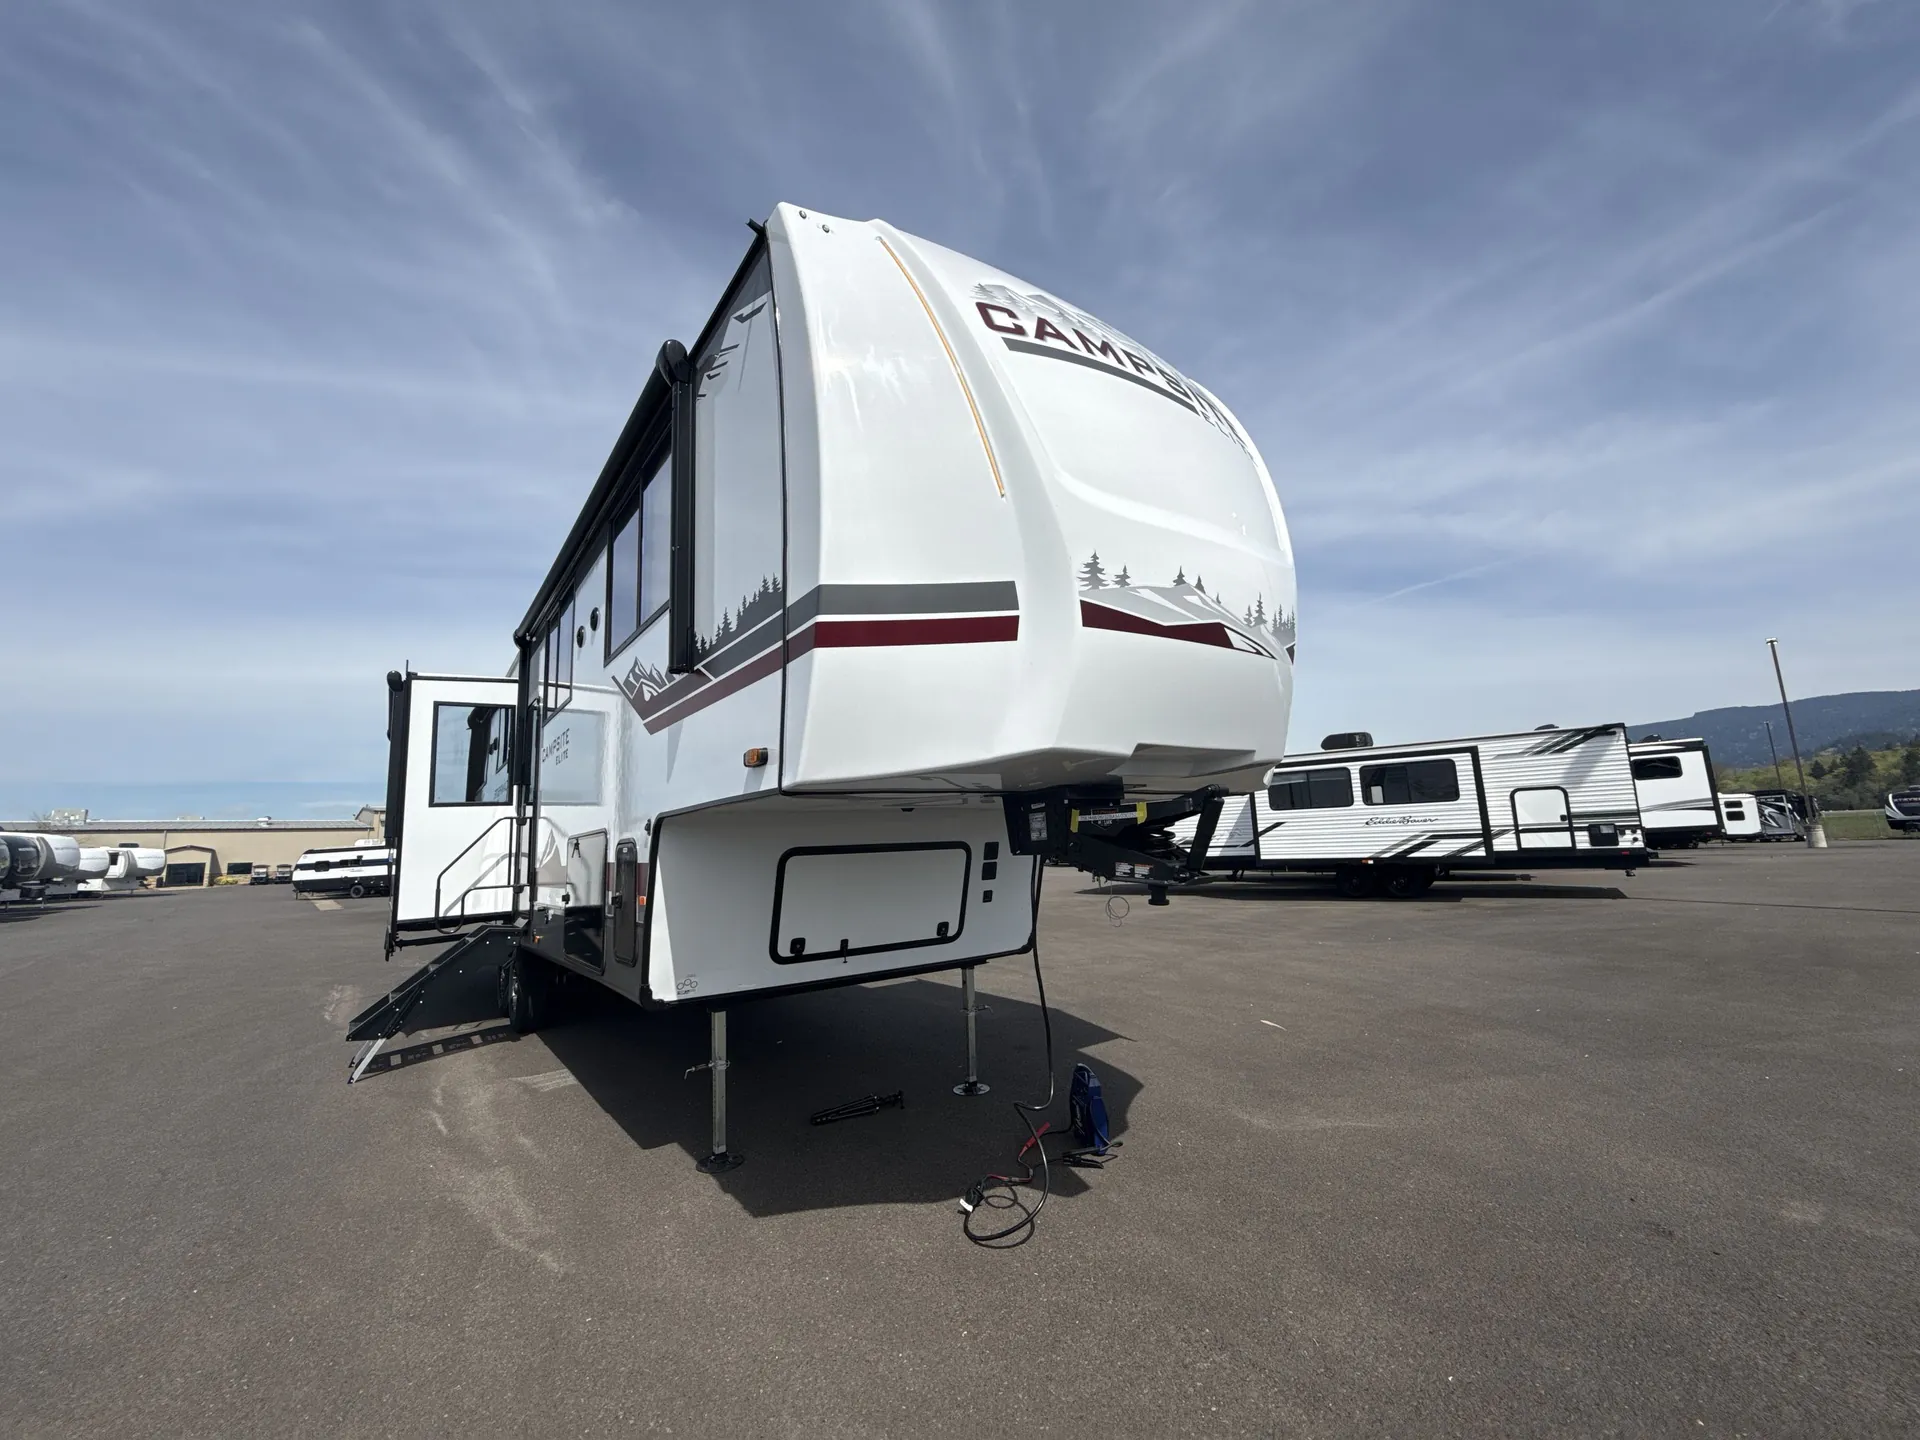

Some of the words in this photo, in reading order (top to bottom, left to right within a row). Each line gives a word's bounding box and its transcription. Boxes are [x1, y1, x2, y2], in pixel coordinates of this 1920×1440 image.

[542, 727, 570, 763] CAMPSITE
[556, 748, 569, 765] ELITE
[1365, 816, 1398, 826] Eddie
[1398, 815, 1439, 825] Bauer
